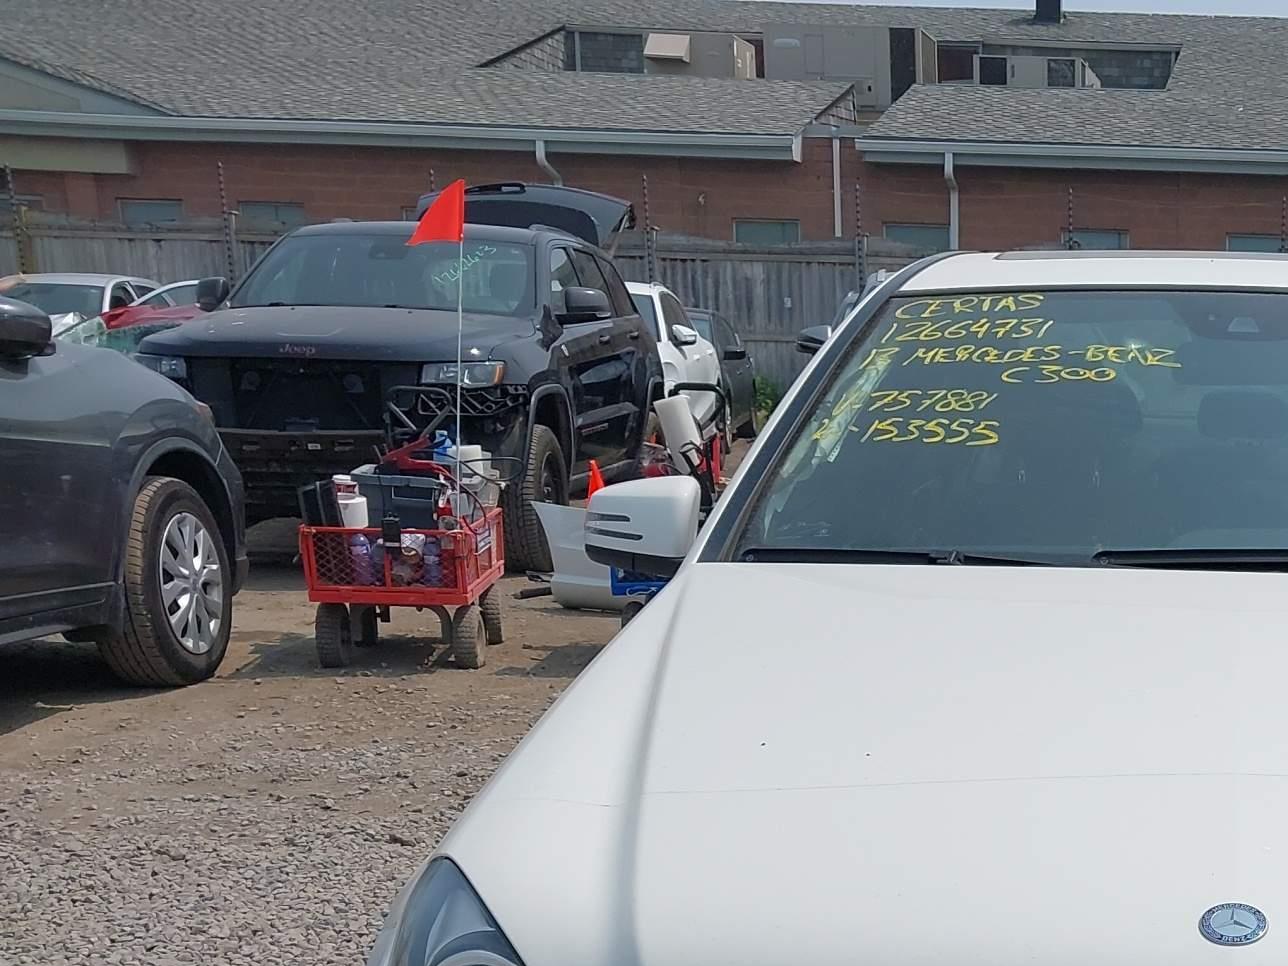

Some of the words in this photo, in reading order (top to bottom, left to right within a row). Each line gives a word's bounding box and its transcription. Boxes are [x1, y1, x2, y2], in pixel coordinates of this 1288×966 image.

[896, 294, 1044, 319] CERTAS
[881, 318, 1054, 343] 12664731
[1001, 364, 1117, 383] C300
